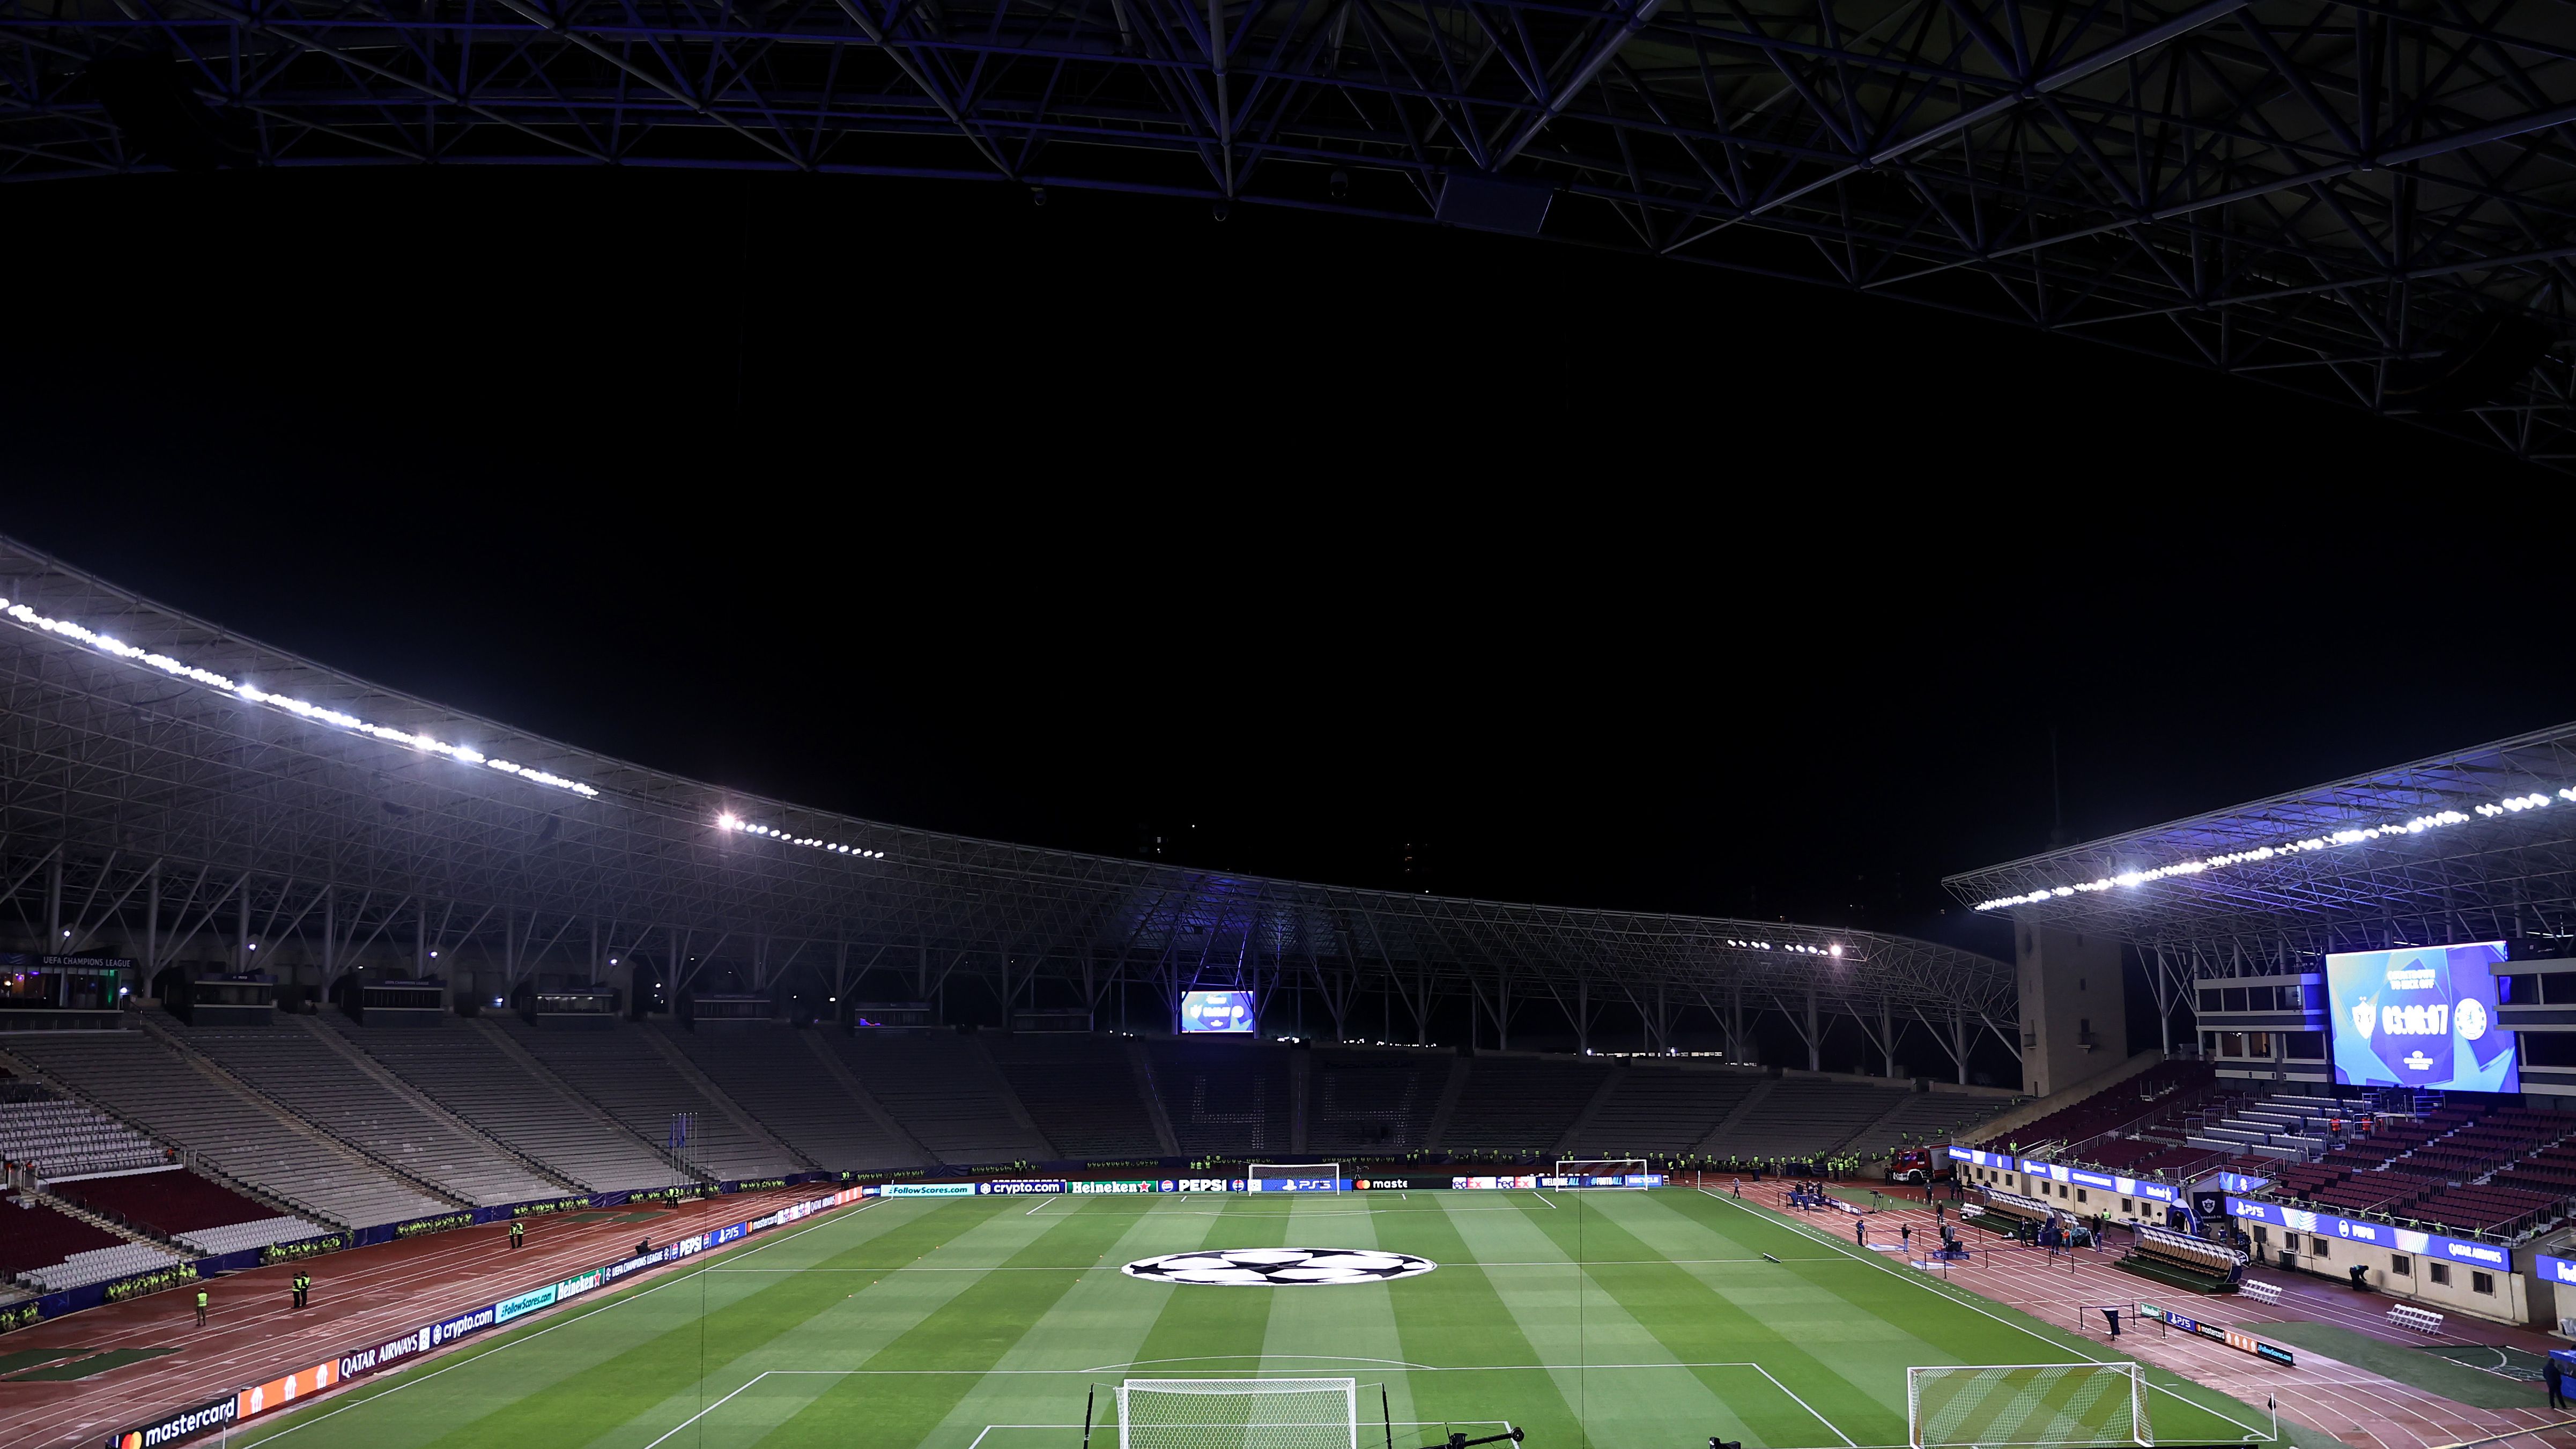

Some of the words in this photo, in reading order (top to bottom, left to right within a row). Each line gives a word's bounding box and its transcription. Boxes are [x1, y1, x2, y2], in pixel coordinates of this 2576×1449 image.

[43, 956, 61, 965] UEFA
[63, 957, 103, 966] CHAMPIONS
[106, 959, 131, 967] LEAGUE
[1072, 1181, 1137, 1193] Heineken
[1179, 1179, 1227, 1192] PEPSI
[1299, 1180, 1331, 1189] PS5
[1496, 1177, 1529, 1189] FedEx
[1542, 1178, 1568, 1186] WELCOME
[1568, 1177, 1579, 1186] ALL
[1591, 1177, 1622, 1185] #FOOTBALL
[994, 1182, 1060, 1194] crypto.com
[810, 1199, 821, 1213] QATAR
[2245, 1204, 2265, 1217] PS5
[753, 1213, 778, 1230] mastercard
[725, 1226, 739, 1240] PS5
[679, 1235, 702, 1257] PEPSI
[2448, 1243, 2471, 1258] QATAR
[2471, 1246, 2502, 1263] AIRWAYS
[612, 1265, 623, 1277] UEFA
[623, 1255, 647, 1274] CHAMPIONS
[647, 1251, 663, 1265] LEAGUE
[557, 1275, 594, 1300] Heineken
[504, 1292, 552, 1317] FollowScores.com
[443, 1309, 493, 1339] crypto.com
[2177, 1317, 2191, 1328] PS5
[2201, 1326, 2225, 1339] mastercard
[341, 1349, 375, 1378] QATAR
[379, 1334, 418, 1363] AIRWAYS
[146, 1398, 235, 1447] mastercard
